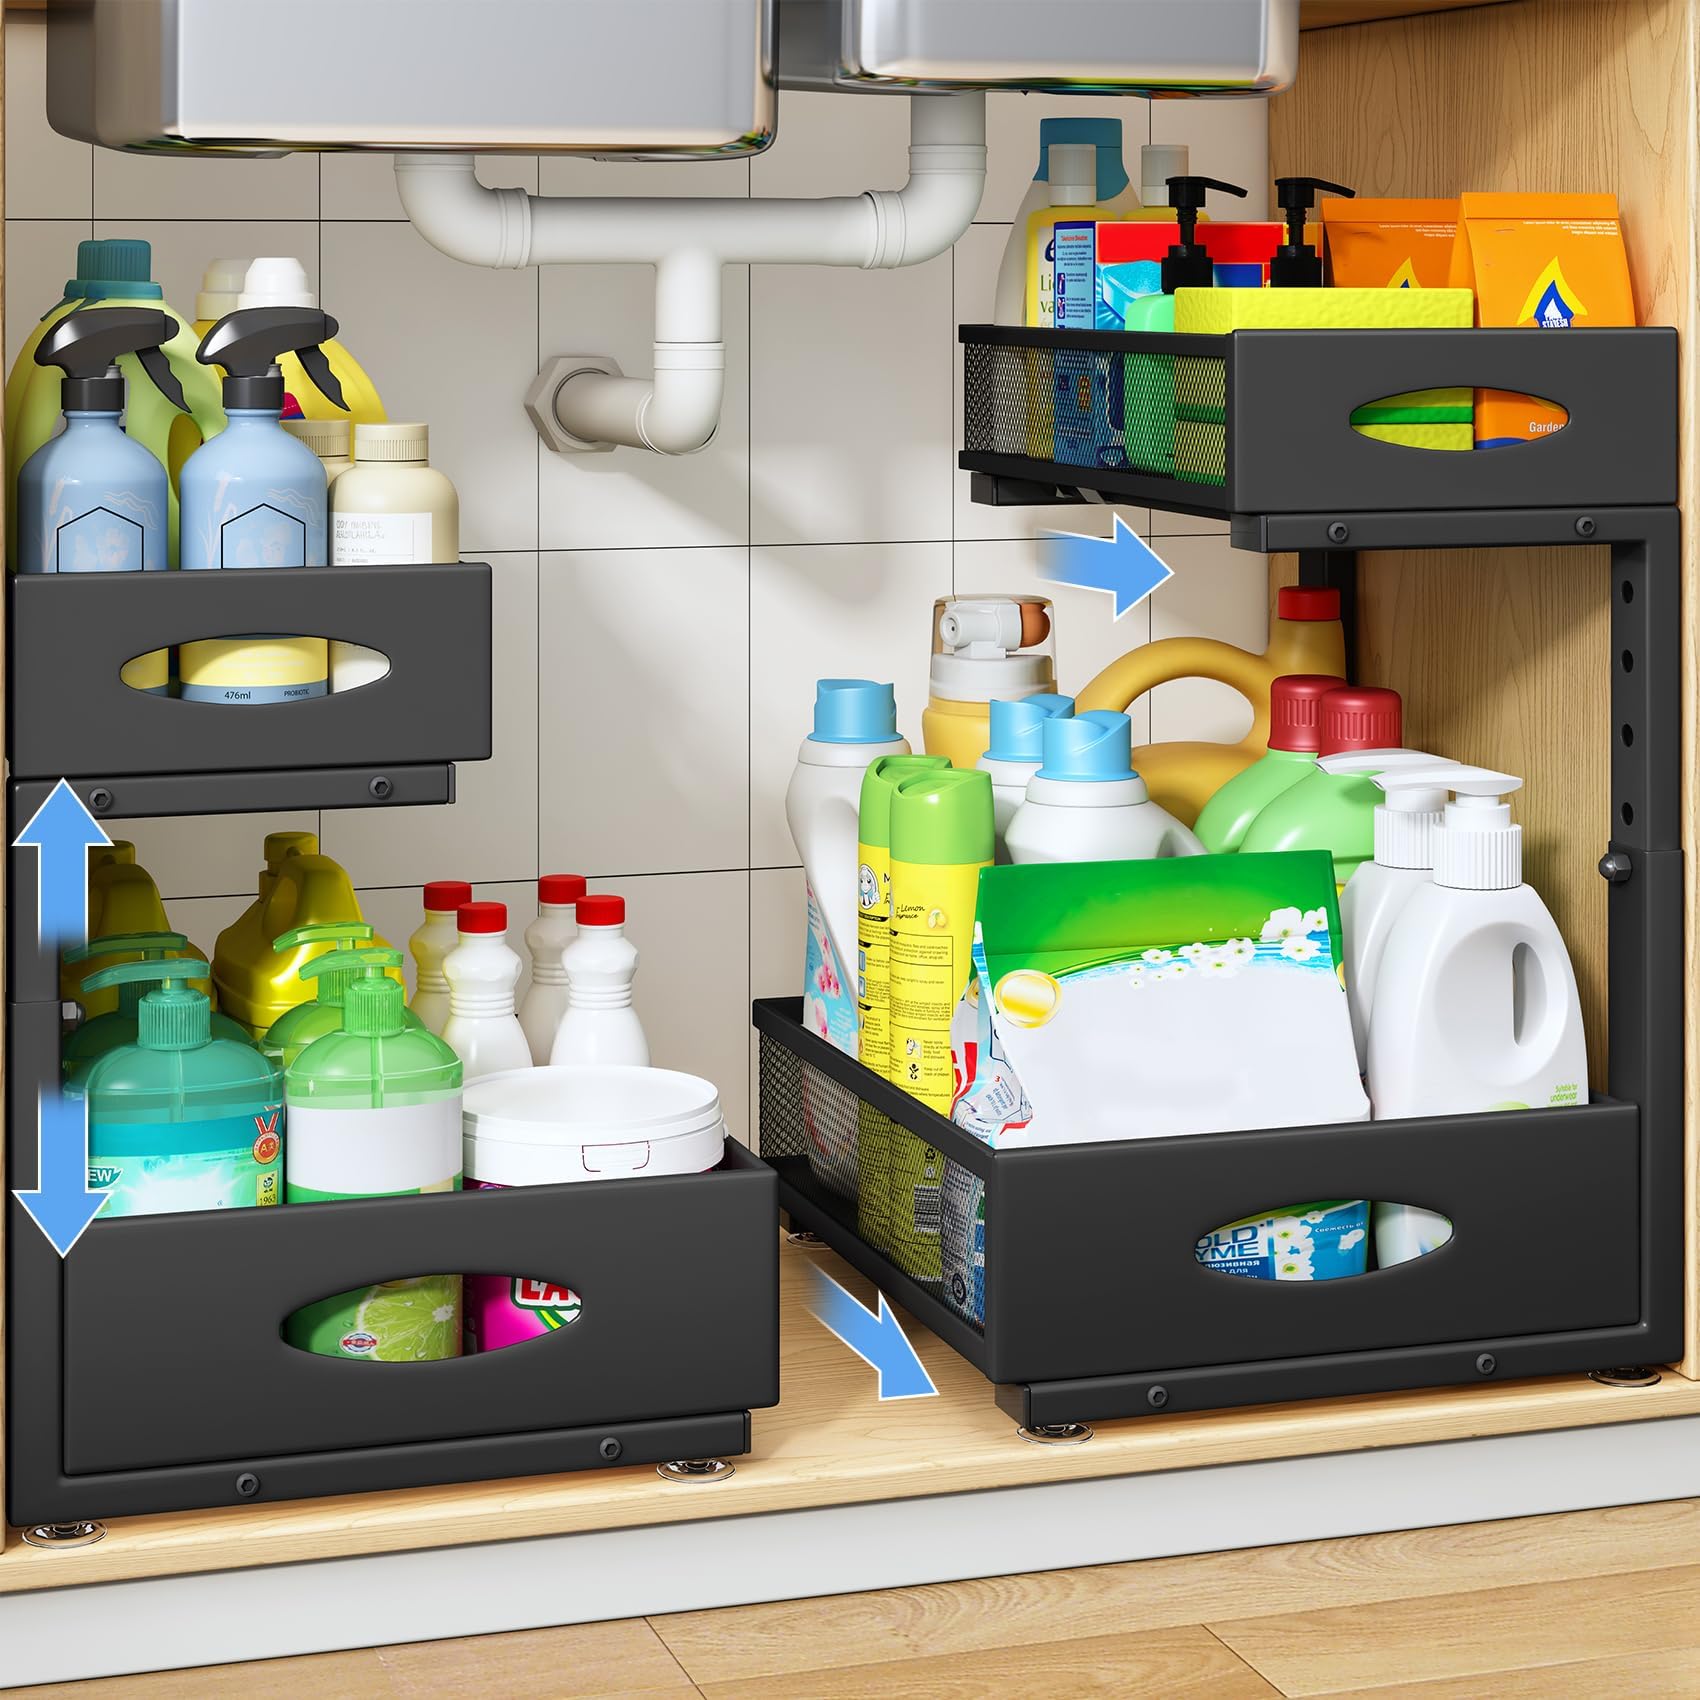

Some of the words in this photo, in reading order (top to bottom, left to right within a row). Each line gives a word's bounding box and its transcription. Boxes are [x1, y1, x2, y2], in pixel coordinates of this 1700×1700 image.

[224, 691, 251, 700] 476ml
[283, 688, 310, 698] PROBIOTIC
[900, 903, 926, 913] Lemon
